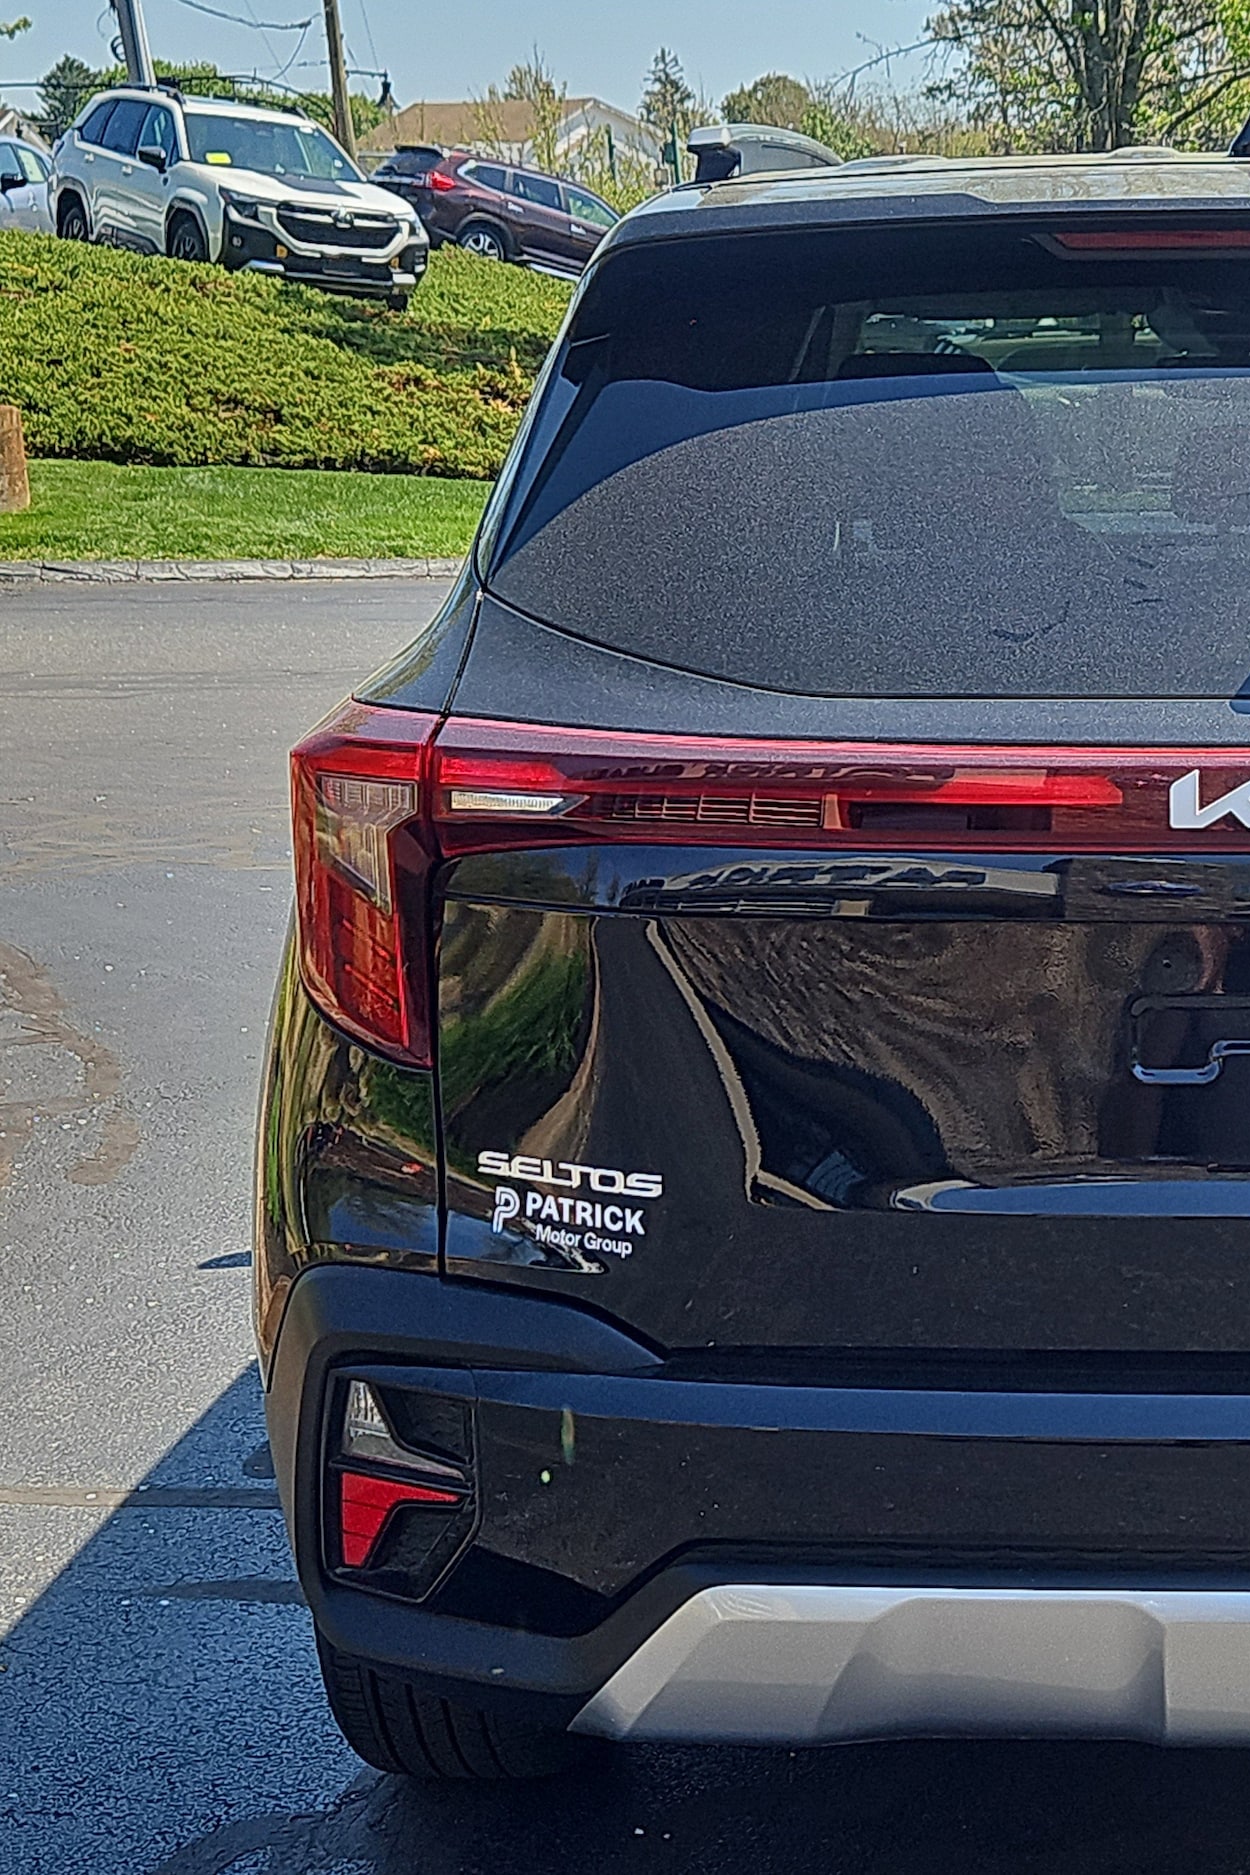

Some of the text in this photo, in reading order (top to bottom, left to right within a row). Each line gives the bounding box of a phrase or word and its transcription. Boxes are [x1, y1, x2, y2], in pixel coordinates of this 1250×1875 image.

[477, 1151, 663, 1198] SELTOS
[526, 1191, 645, 1235] PATRICK
[535, 1223, 632, 1258] Motor Group
